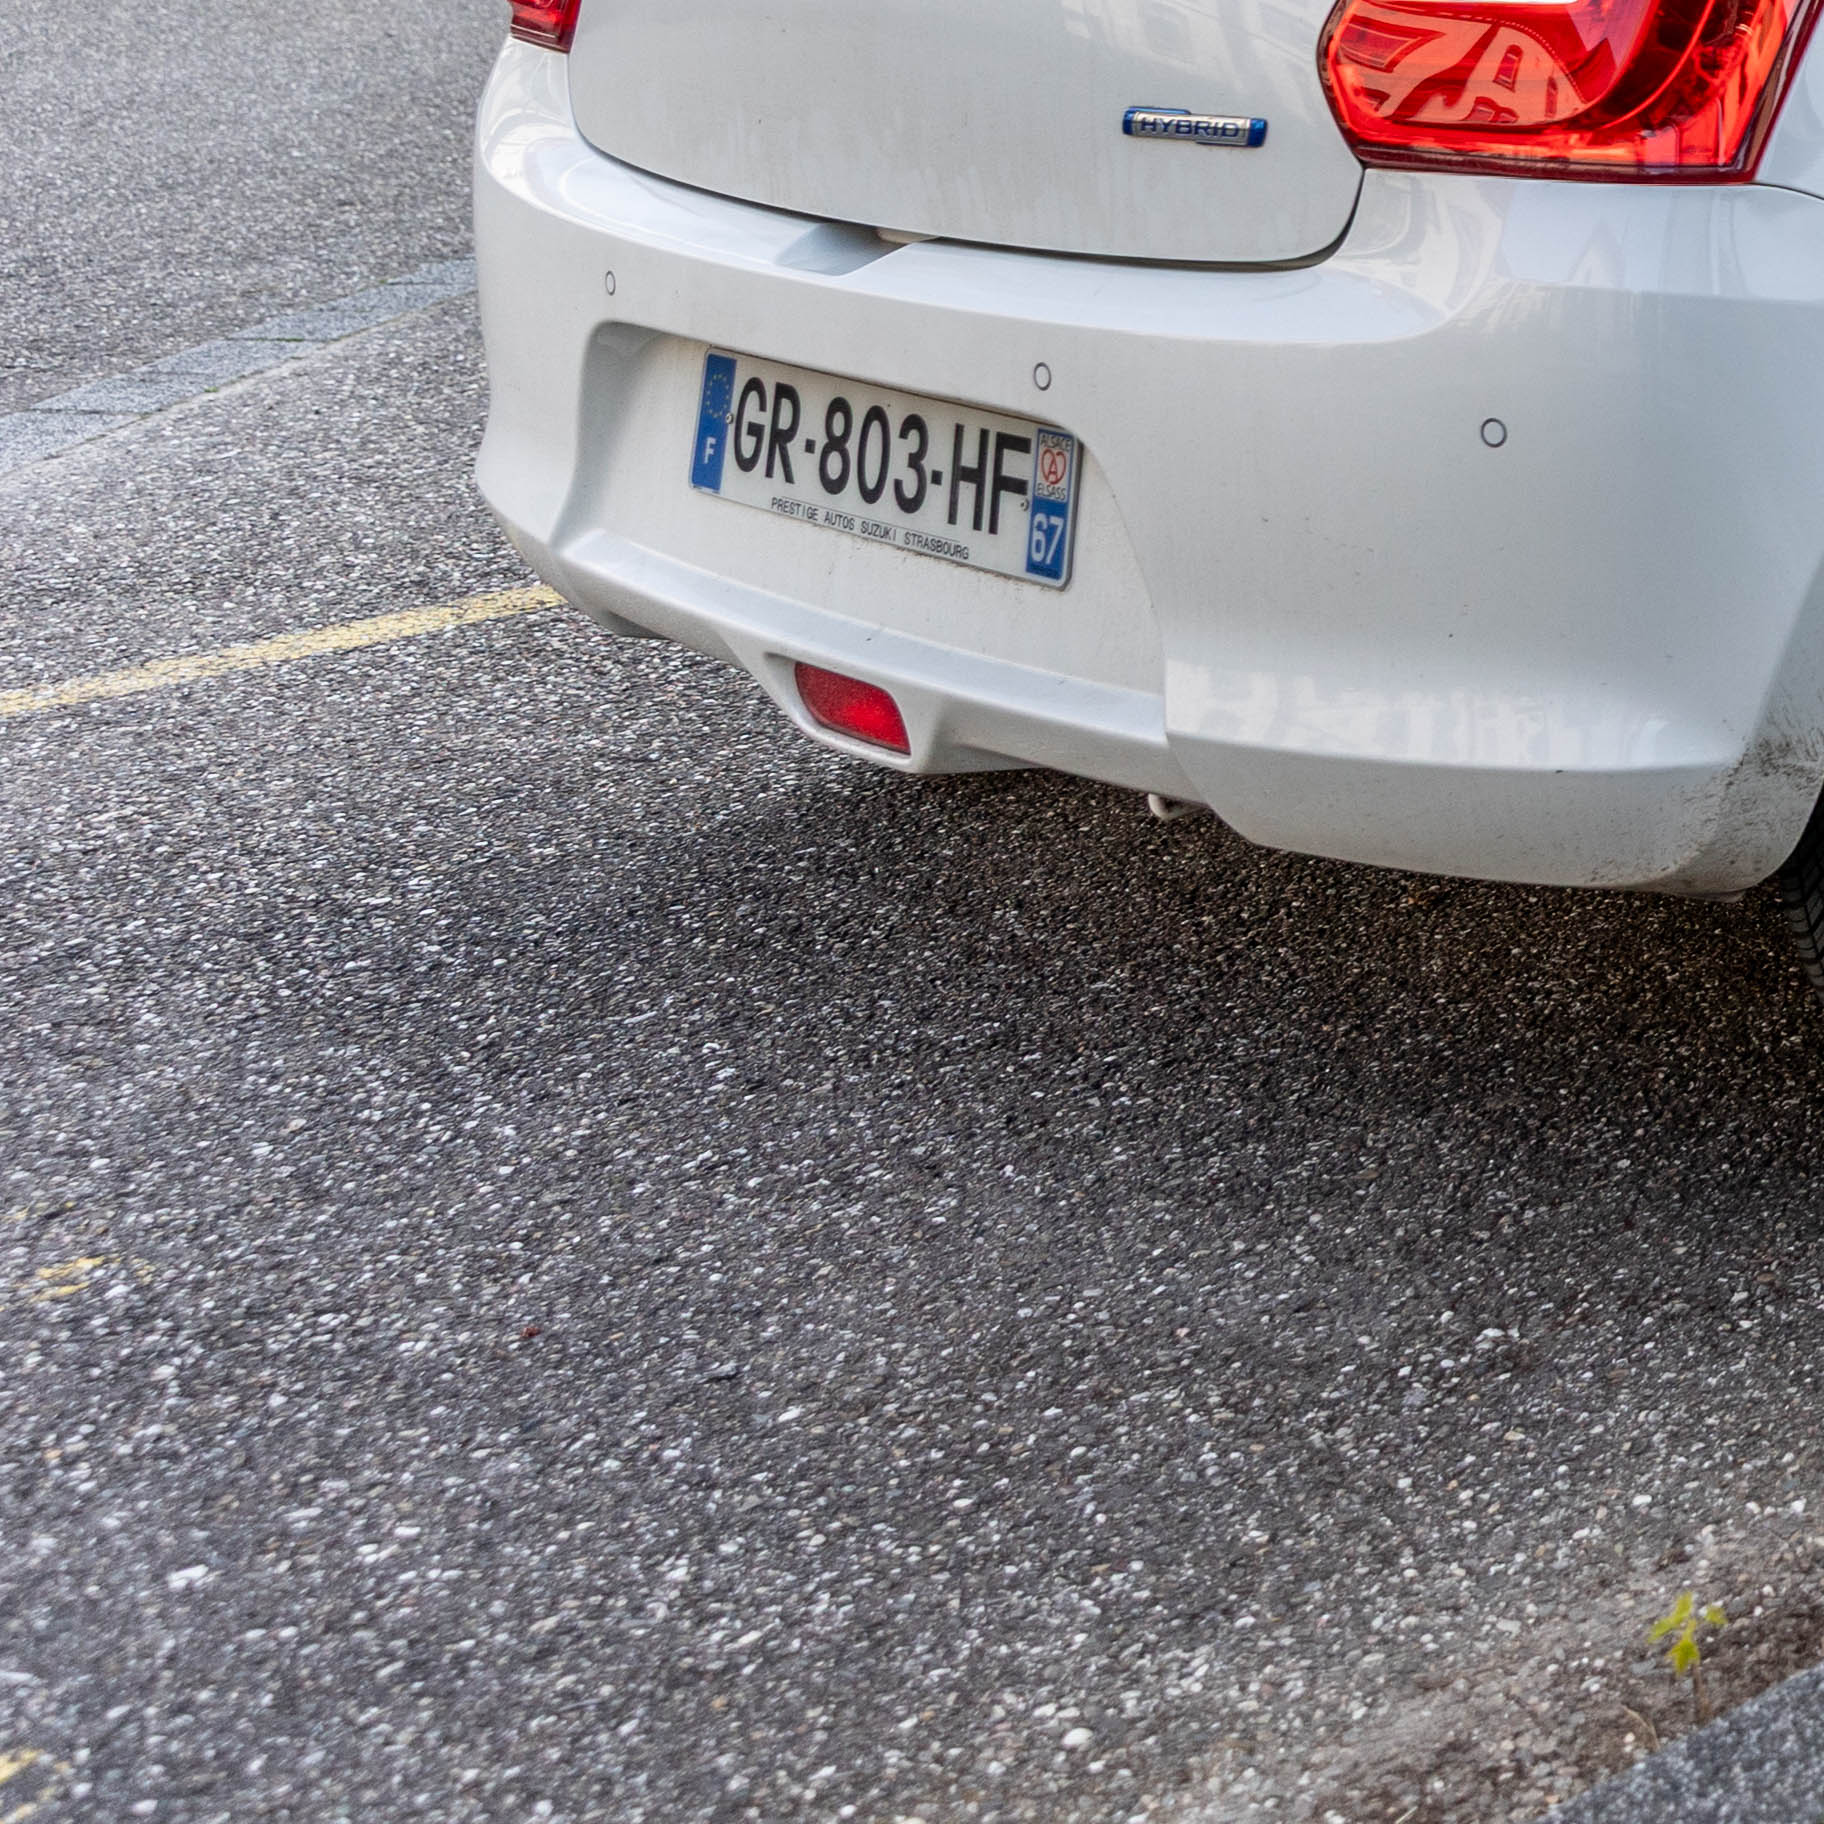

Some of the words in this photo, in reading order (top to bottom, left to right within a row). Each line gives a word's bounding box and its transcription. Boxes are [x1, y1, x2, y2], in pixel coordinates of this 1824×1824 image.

[1140, 117, 1240, 138] HYBRID
[703, 437, 716, 466] F
[734, 376, 1032, 535] GR-803-HF
[1039, 434, 1072, 453] ALSACE
[1036, 482, 1067, 502] ELSASS
[771, 496, 818, 522] PRESTIGE
[824, 511, 856, 531] AUTOS
[860, 520, 897, 542] SUZUKI
[904, 531, 970, 560] STRASBOURG
[1030, 512, 1065, 565] 67
